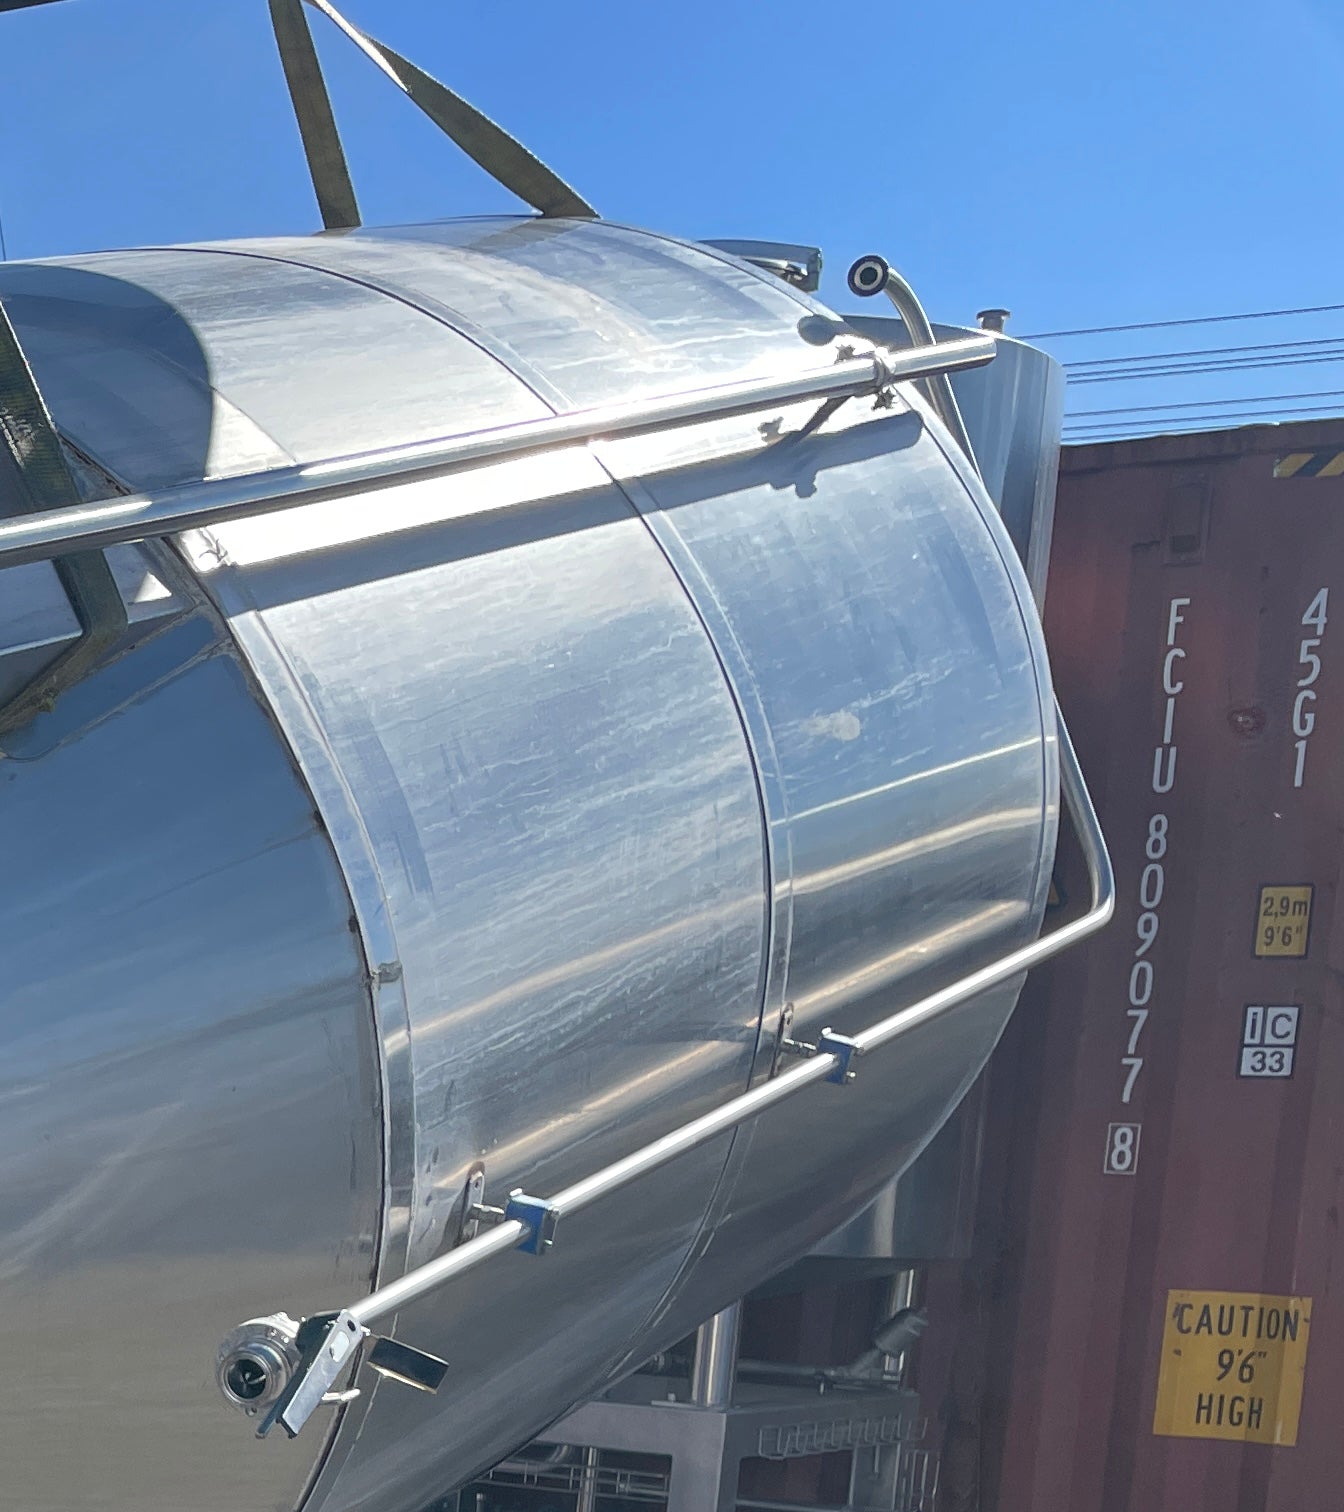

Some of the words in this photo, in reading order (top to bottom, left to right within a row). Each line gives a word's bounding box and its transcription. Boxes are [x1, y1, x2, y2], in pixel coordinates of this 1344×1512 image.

[1152, 597, 1191, 793] FCIU
[1292, 587, 1330, 788] 45G1
[1121, 813, 1169, 1103] 809077
[1250, 1050, 1286, 1074] 33
[1111, 1126, 1134, 1171] 8
[1175, 1303, 1300, 1342] CAUTION
[1194, 1391, 1264, 1430] HIGH
